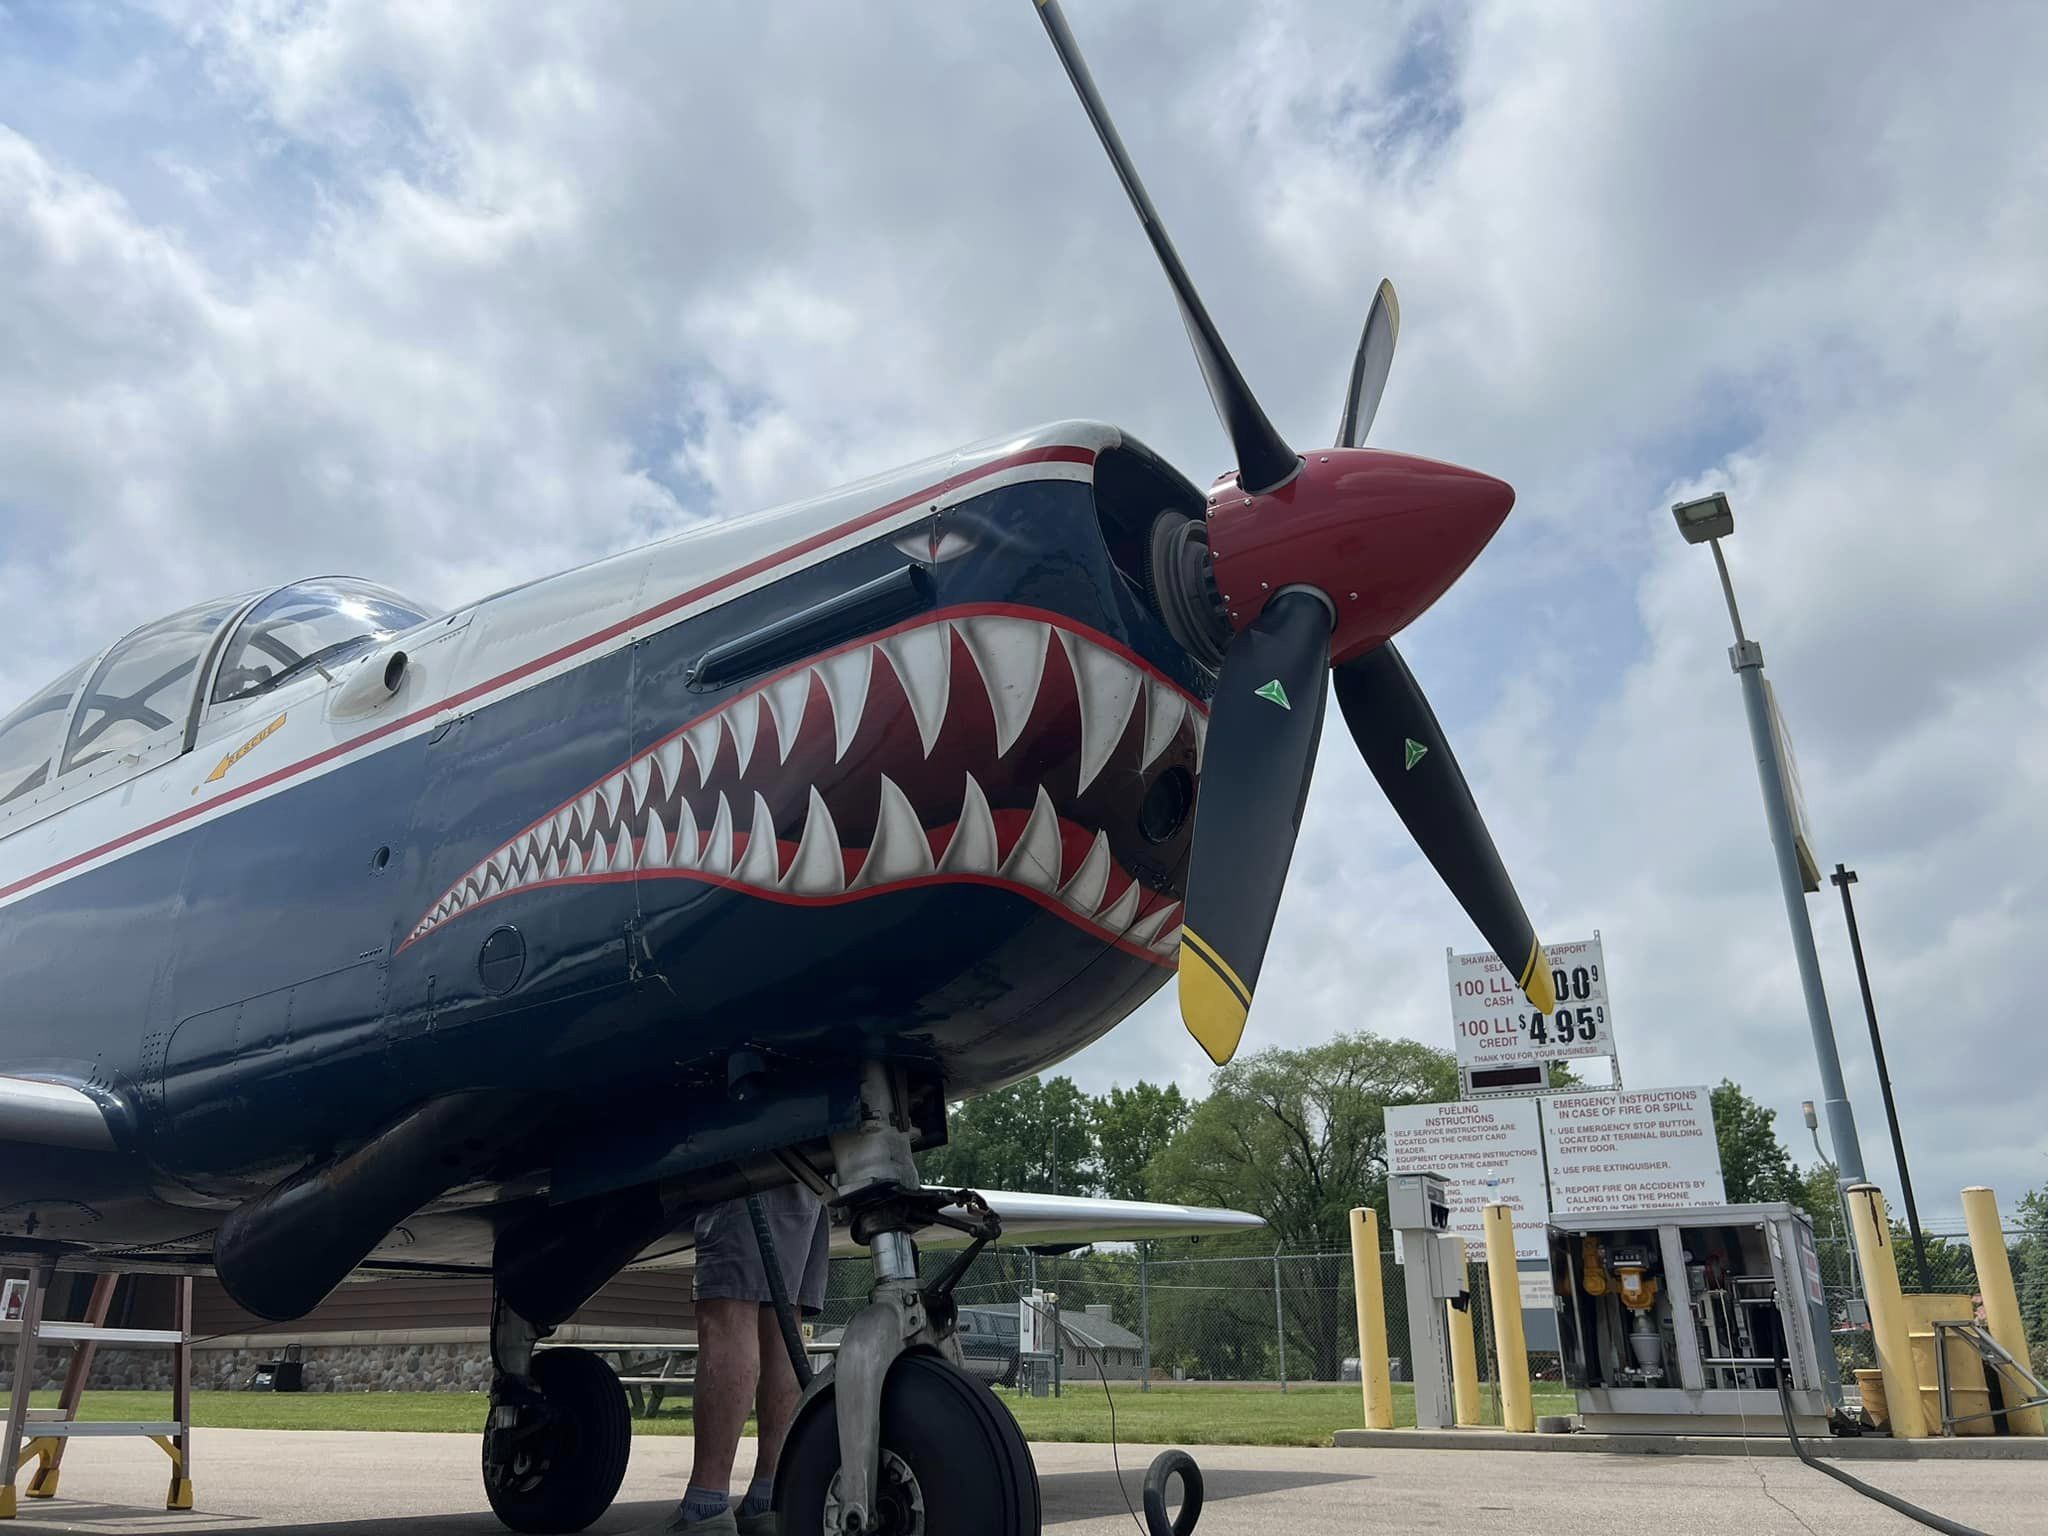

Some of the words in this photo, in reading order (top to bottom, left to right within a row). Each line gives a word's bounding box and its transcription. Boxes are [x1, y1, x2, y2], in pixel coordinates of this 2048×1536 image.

[1551, 944, 1586, 955] AIRPORT
[1484, 964, 1504, 973] SELF
[1548, 957, 1565, 966] UEL
[1456, 980, 1484, 996] 100
[1490, 977, 1512, 993] LL
[1484, 996, 1514, 1008] CASH
[1459, 1019, 1488, 1037] 100
[1495, 1017, 1517, 1033] LL
[1479, 1036, 1519, 1048] CREDIT
[1474, 1055, 1499, 1063] THANK
[1535, 1050, 1556, 1058] YOUR
[1553, 1096, 1616, 1109] EMERGENCY
[1619, 1090, 1696, 1104] INSTRUCTIONS
[1439, 1105, 1479, 1116] FUELING
[1559, 1110, 1569, 1119] IN
[1572, 1108, 1599, 1118] CASE
[1602, 1107, 1616, 1116] OF
[1619, 1105, 1642, 1115] FIRE
[1645, 1104, 1660, 1113] OR
[1664, 1102, 1693, 1112] SPILL
[1425, 1114, 1495, 1127] INSTRUCTIONS
[1558, 1126, 1575, 1135] USE
[1577, 1122, 1630, 1133] EMERGENCY
[1633, 1121, 1656, 1130] STOP
[1659, 1119, 1696, 1128] BUTTON
[1413, 1129, 1444, 1137] SERVICE
[1445, 1125, 1499, 1134] INSTRUCTIONS
[1559, 1135, 1598, 1144] LOCATED
[1601, 1133, 1611, 1142] AT
[1613, 1131, 1658, 1141] TERMINAL
[1659, 1128, 1703, 1138] BUILDING
[1394, 1138, 1428, 1146] LOCATED
[1457, 1134, 1484, 1142] CREDIT
[1485, 1133, 1507, 1141] CARD
[1396, 1154, 1438, 1163] EQUIPMENT
[1439, 1152, 1481, 1161] OPERATING
[1483, 1149, 1538, 1158] INSTRUCTIONS
[1560, 1145, 1589, 1154] ENTRY
[1412, 1162, 1446, 1170] LOCATED
[1476, 1159, 1508, 1168] CABINET
[1562, 1166, 1580, 1174] USE
[1582, 1164, 1601, 1173] FIRE
[1603, 1161, 1671, 1172] EXTINGUISHER.
[1565, 1185, 1600, 1194] REPORT
[1602, 1184, 1622, 1192] FIRE
[1624, 1183, 1637, 1191] OR
[1639, 1181, 1691, 1190] ACCIDENTS
[1692, 1180, 1706, 1188] BY
[1566, 1195, 1604, 1204] CALLING
[1606, 1194, 1619, 1202] 911
[1622, 1193, 1635, 1201] ON
[1637, 1192, 1656, 1200] THE
[1657, 1190, 1689, 1199] PHONE
[1456, 1223, 1485, 1231] NOZZLE
